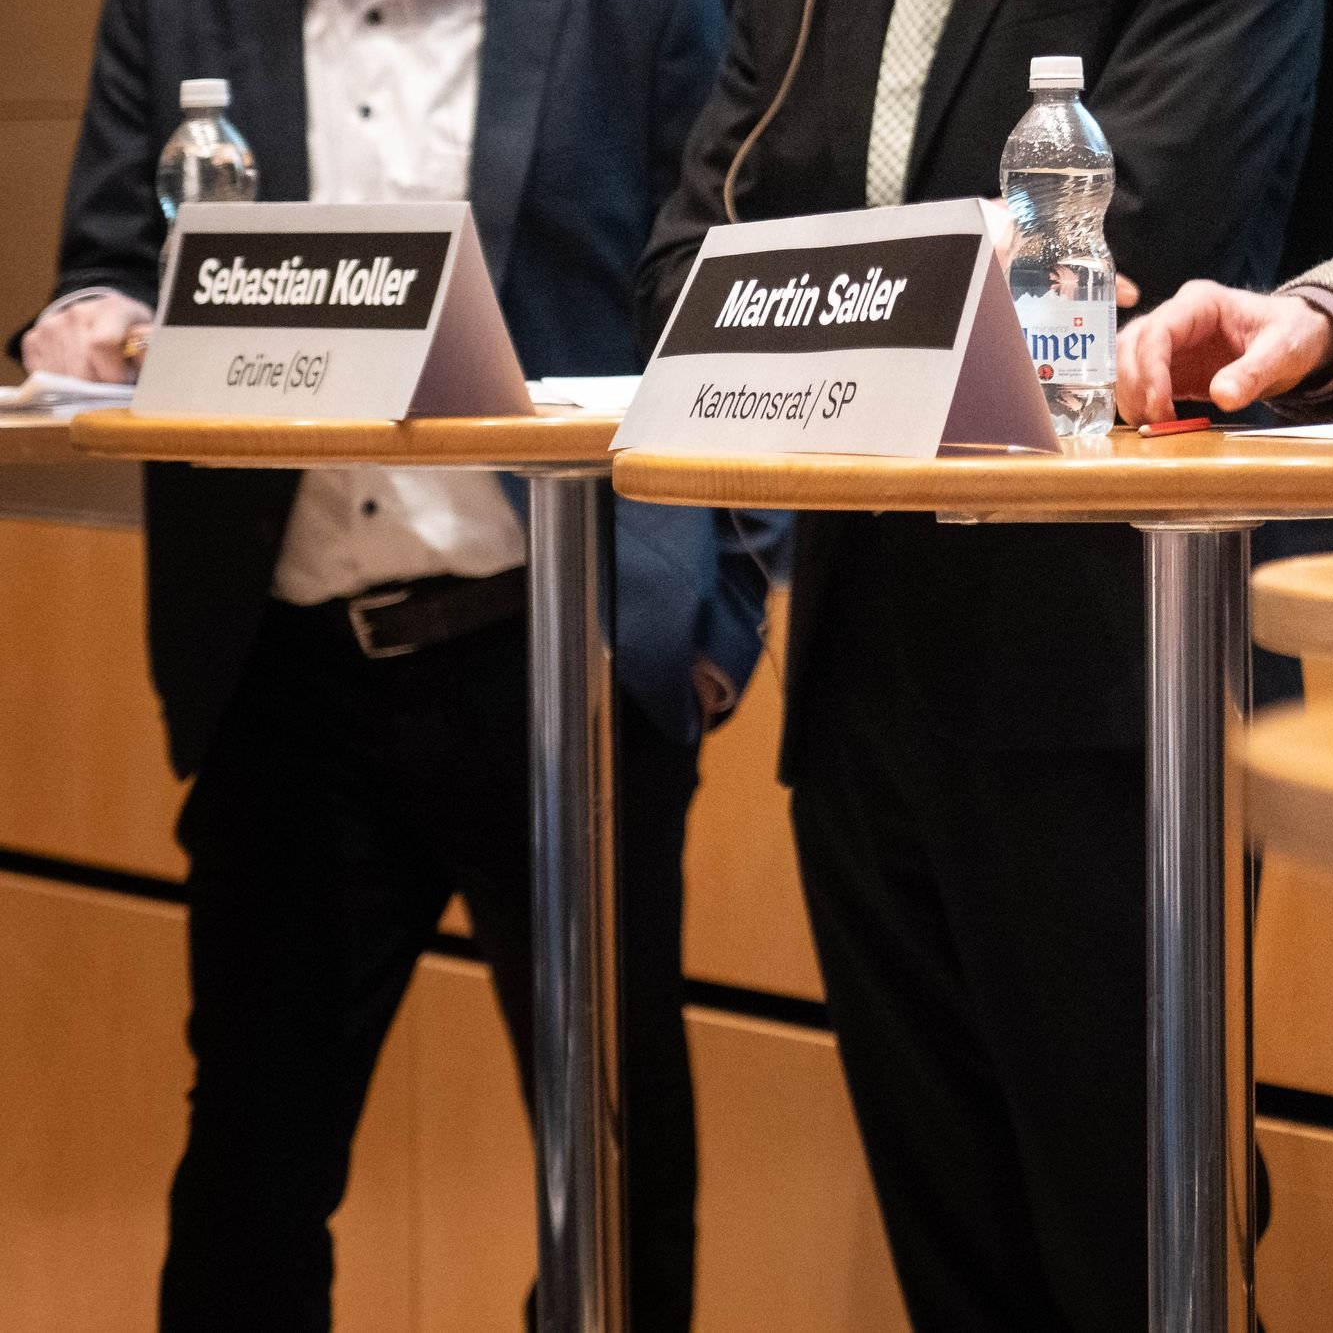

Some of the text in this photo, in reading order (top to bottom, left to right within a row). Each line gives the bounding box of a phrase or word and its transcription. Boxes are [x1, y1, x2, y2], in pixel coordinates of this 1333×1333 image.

[193, 255, 419, 306] Sebastian Koller
[714, 266, 908, 328] Martin Sailer
[226, 349, 330, 395] Grüne (SG)
